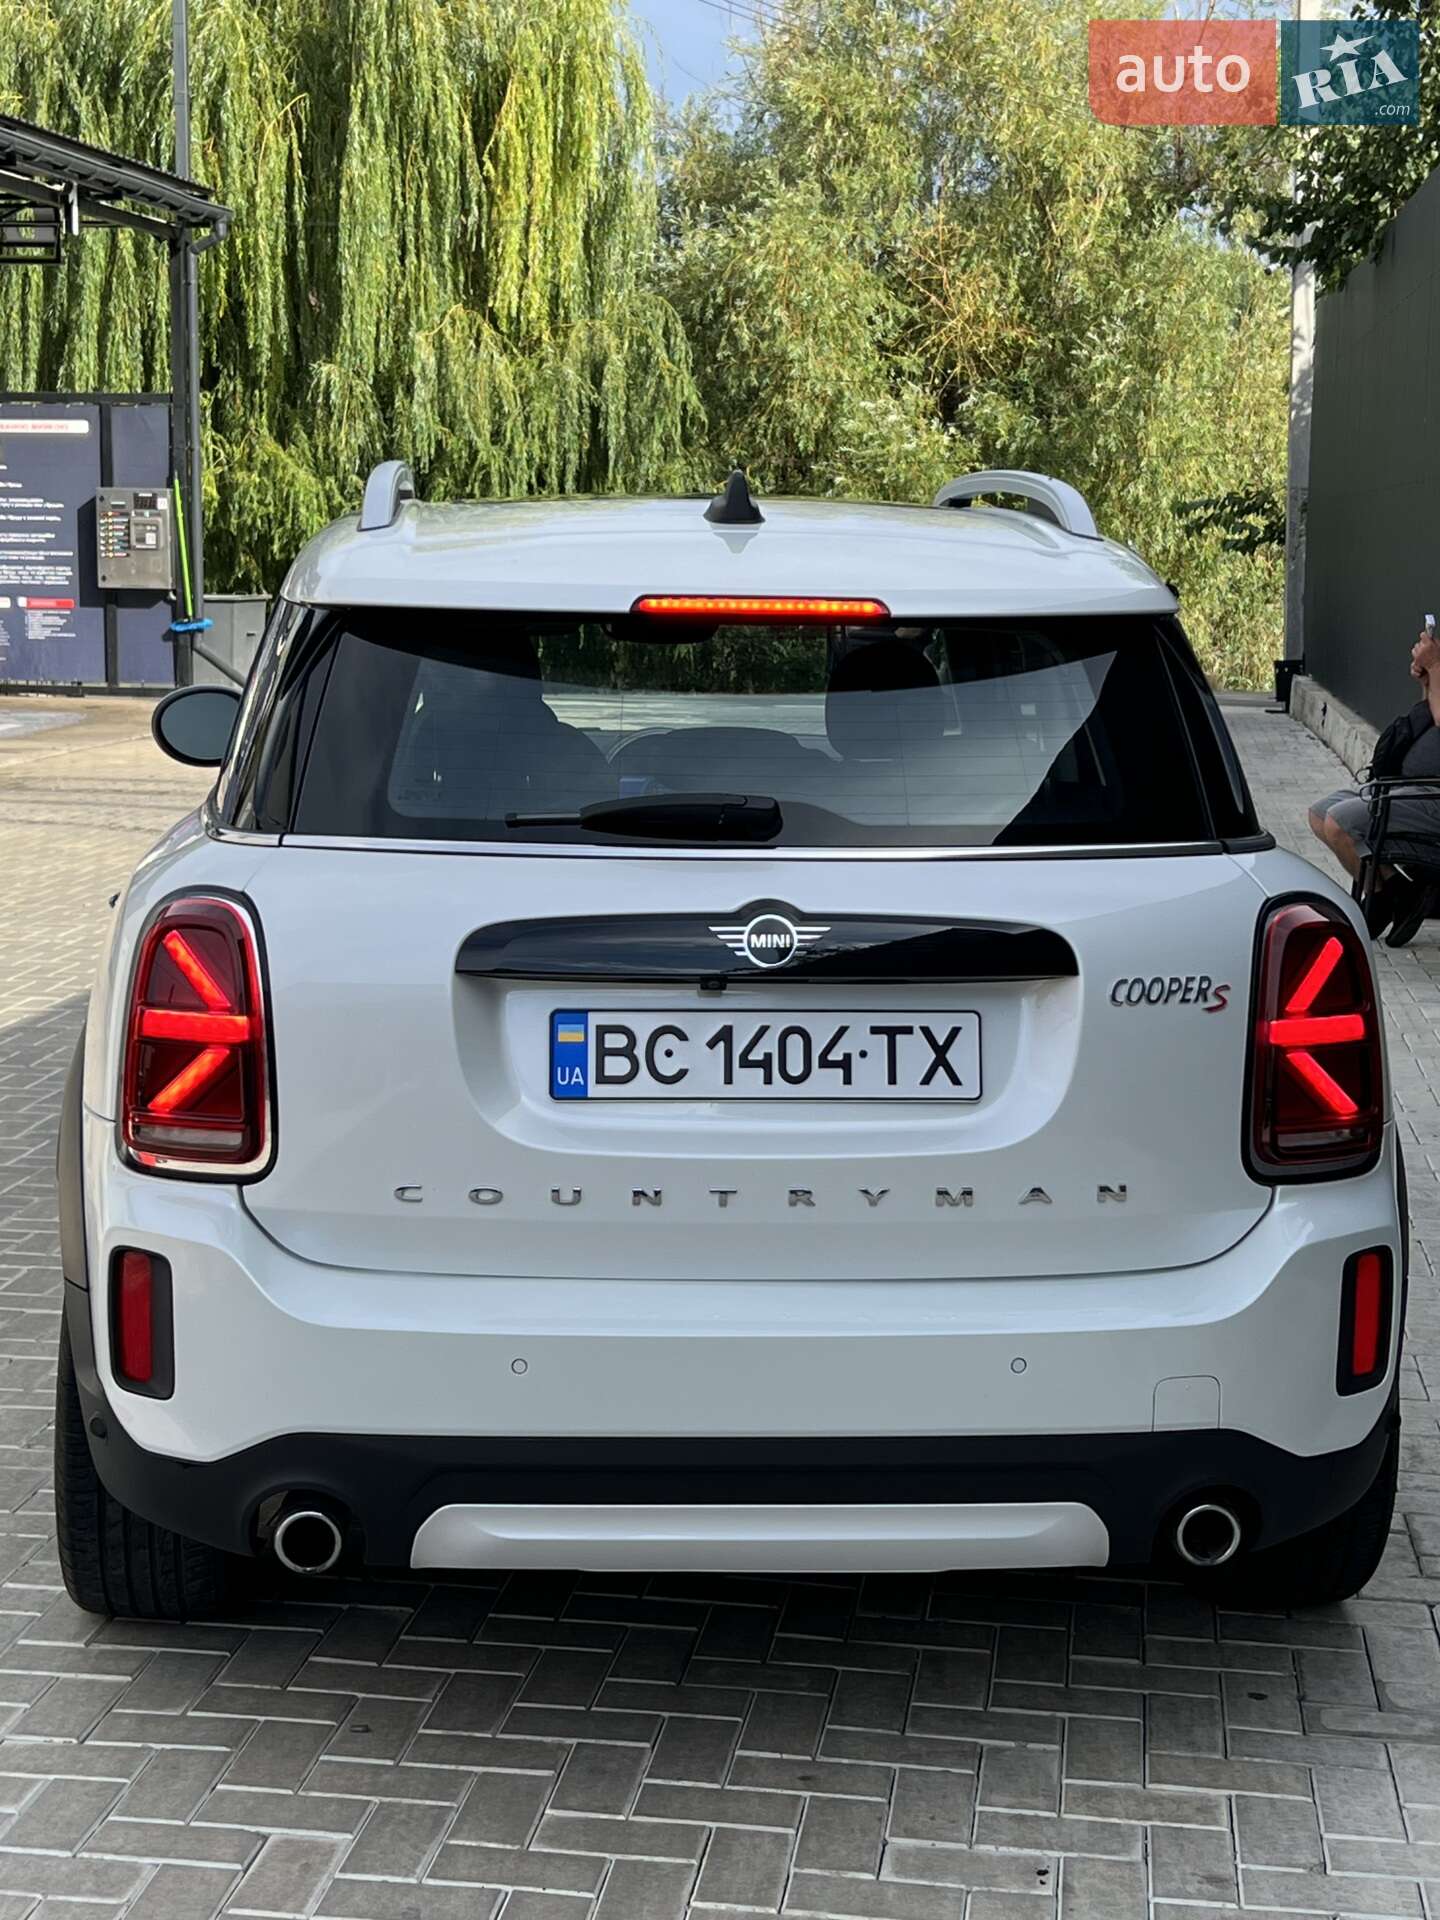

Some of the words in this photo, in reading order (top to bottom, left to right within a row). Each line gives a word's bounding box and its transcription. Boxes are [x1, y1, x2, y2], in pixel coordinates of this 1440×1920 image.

[750, 933, 791, 948] MINI
[595, 1024, 689, 1085] BC
[705, 1024, 853, 1085] 1404
[869, 1024, 963, 1085] TX
[557, 1067, 584, 1086] UA
